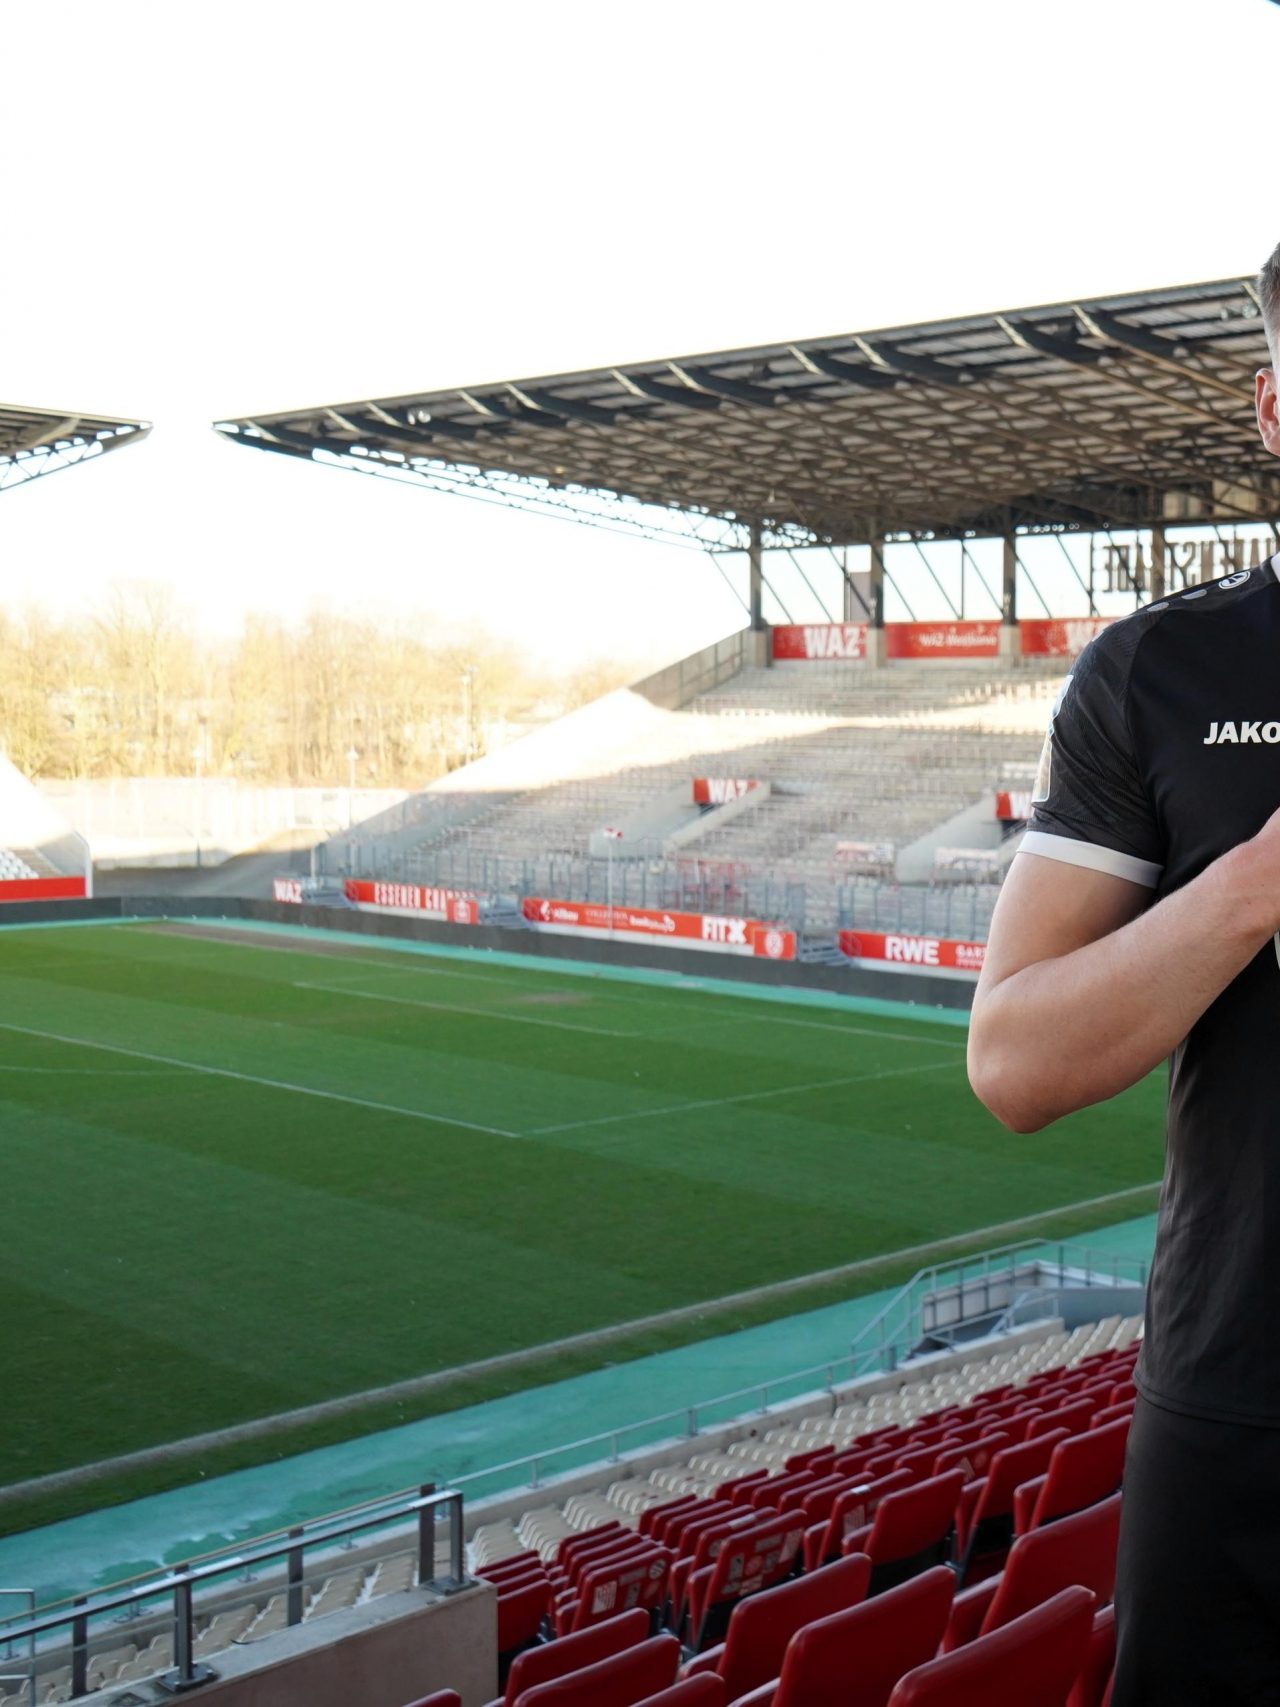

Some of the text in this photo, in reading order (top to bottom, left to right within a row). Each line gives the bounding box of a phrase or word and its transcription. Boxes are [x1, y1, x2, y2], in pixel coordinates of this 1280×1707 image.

[804, 626, 860, 657] WAZ
[274, 880, 302, 903] WAZ
[701, 914, 747, 945] FITX
[885, 935, 940, 965] RWE
